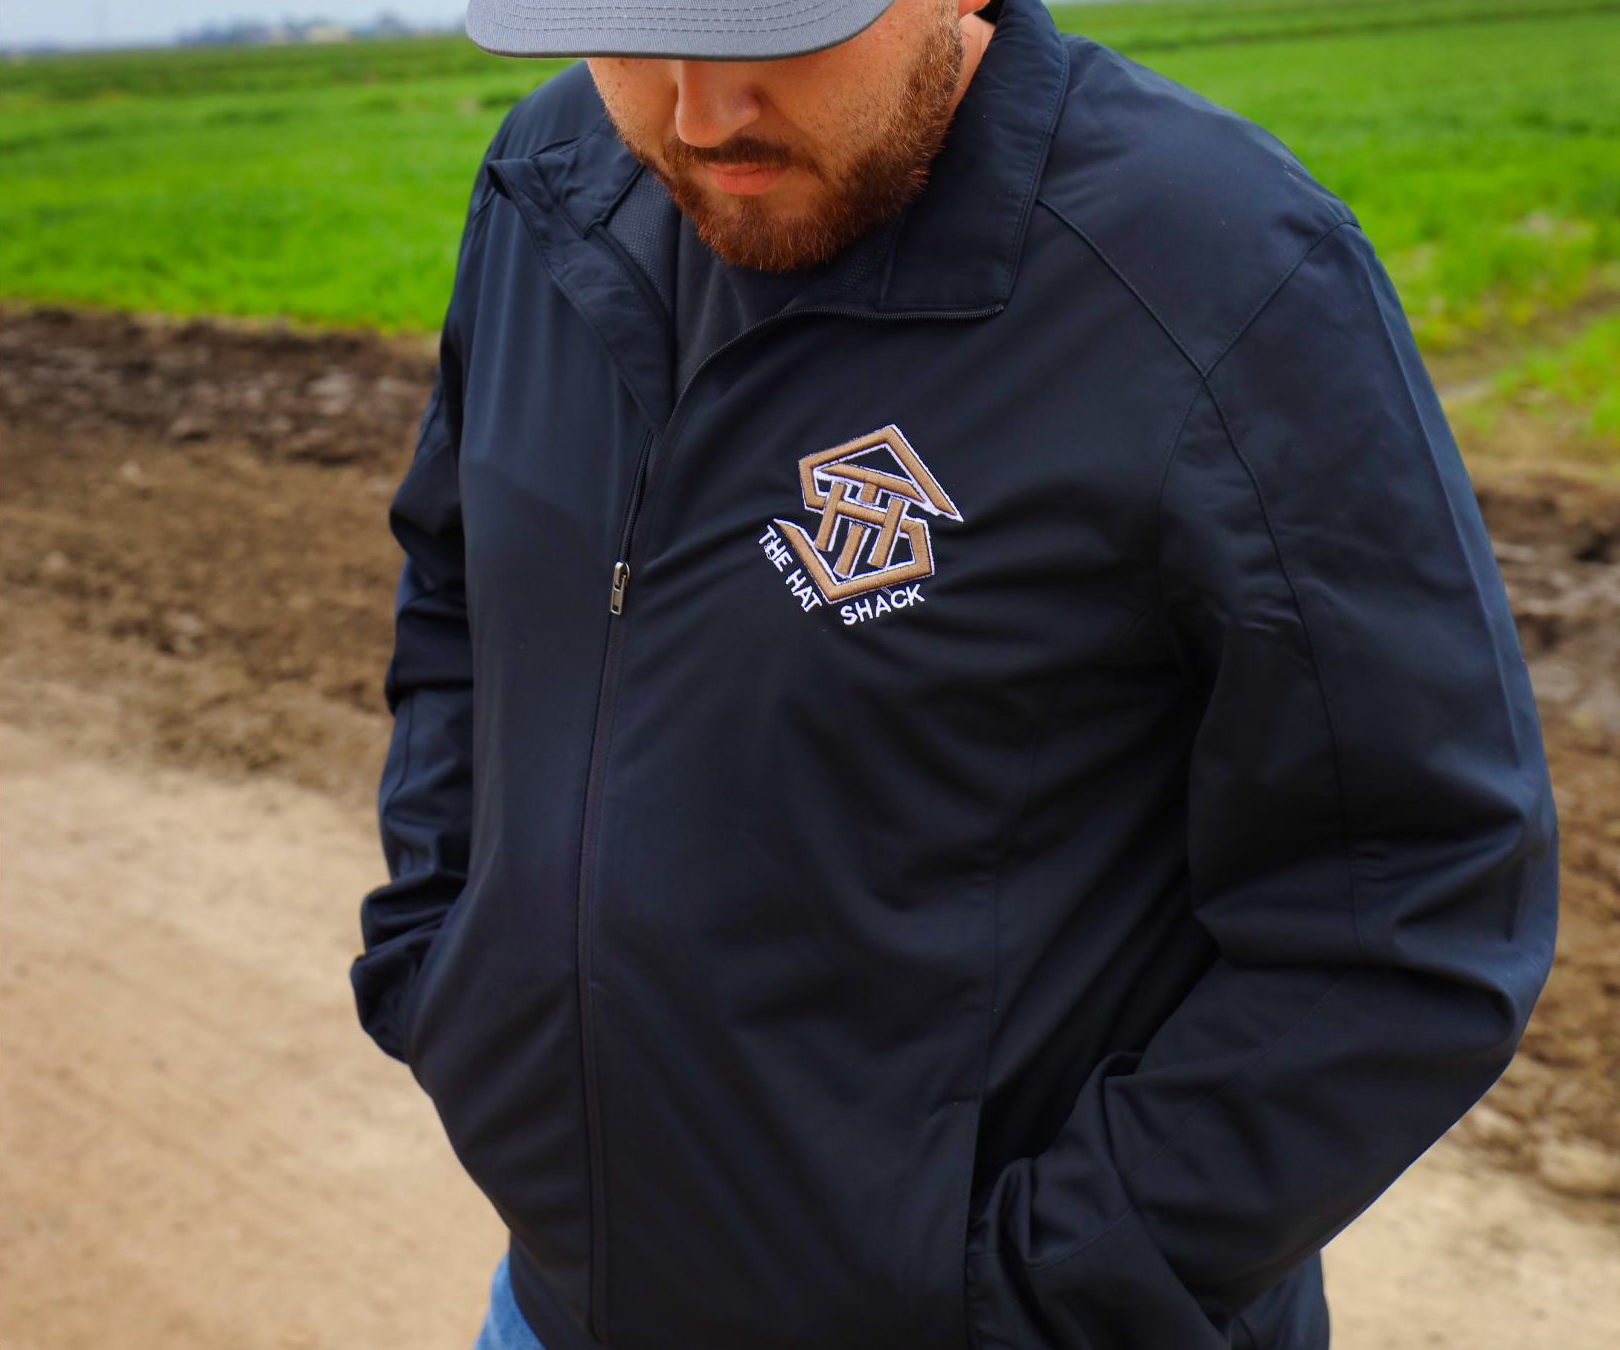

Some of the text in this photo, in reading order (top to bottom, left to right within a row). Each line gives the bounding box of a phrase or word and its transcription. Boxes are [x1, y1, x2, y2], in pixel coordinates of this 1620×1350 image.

[758, 524, 926, 626] THE HAT SHACK
